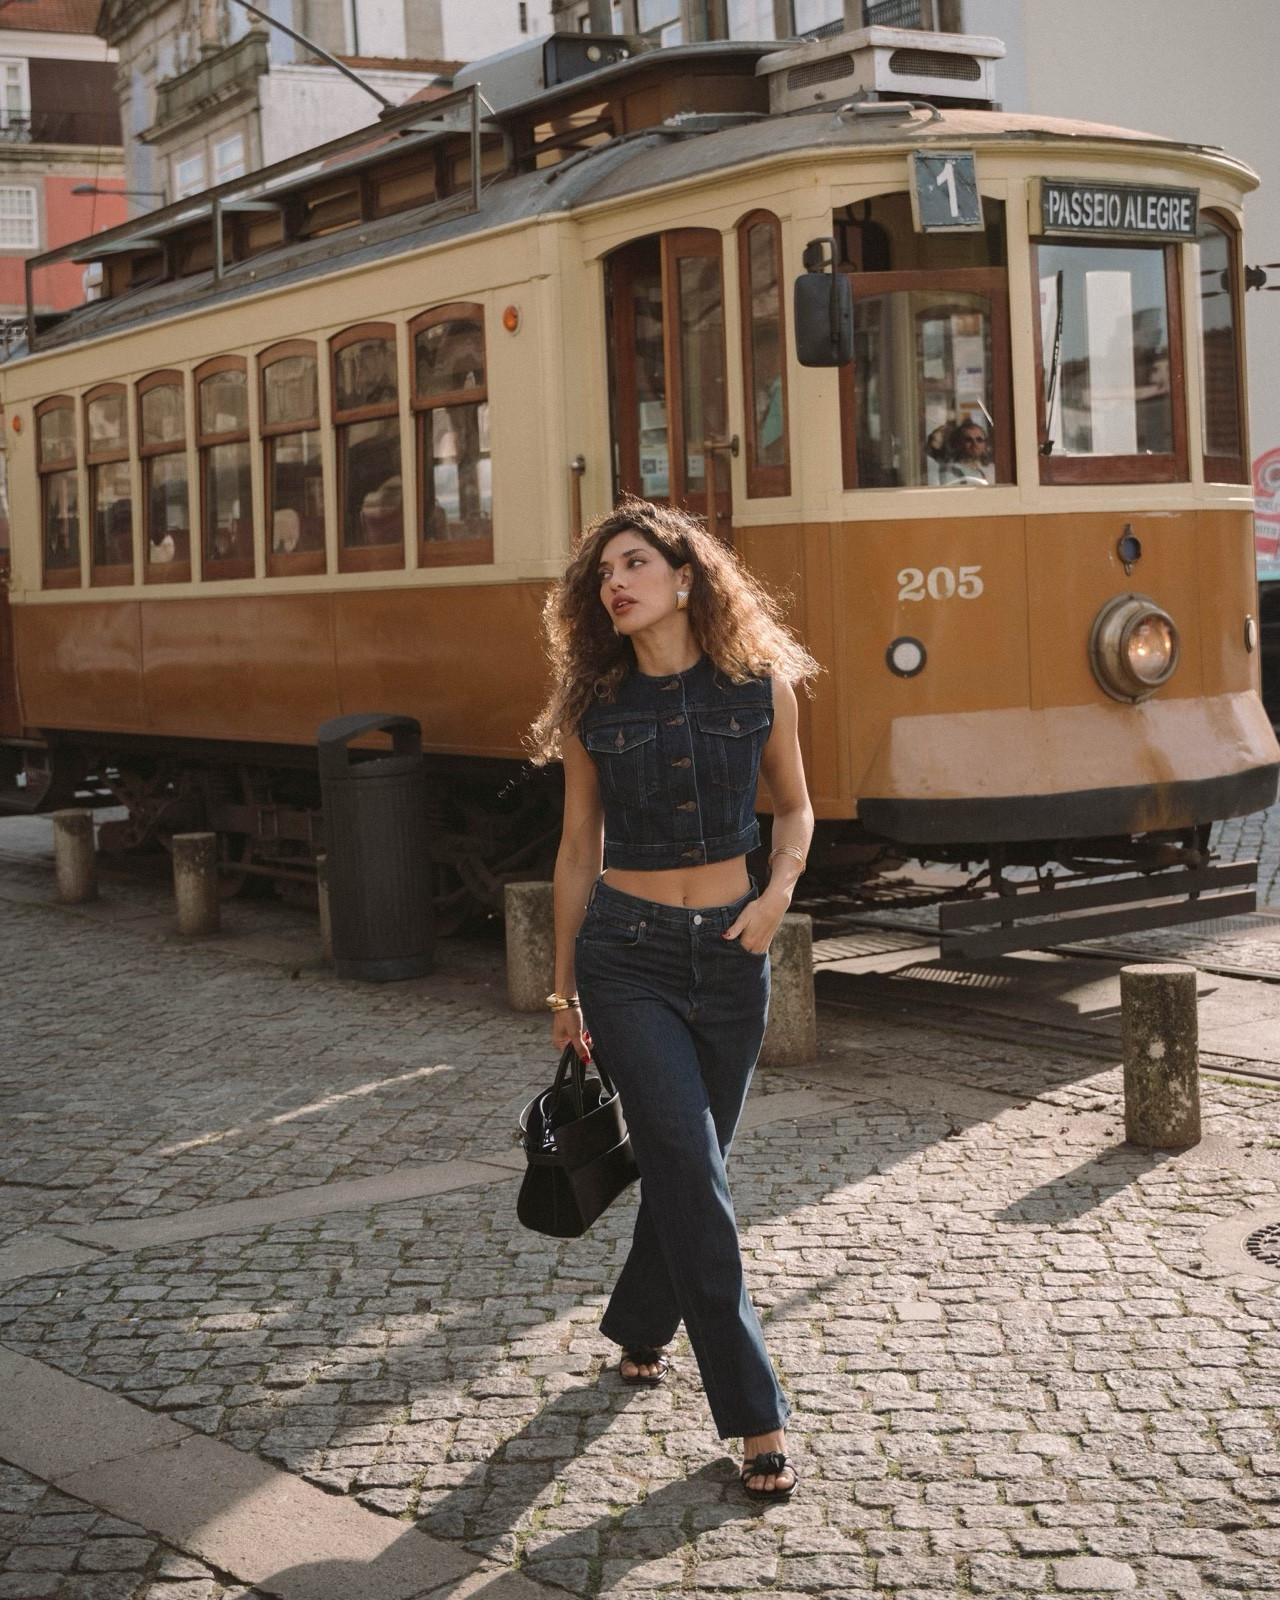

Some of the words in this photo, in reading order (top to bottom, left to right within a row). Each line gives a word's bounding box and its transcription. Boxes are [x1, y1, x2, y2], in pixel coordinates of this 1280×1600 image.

[936, 160, 960, 218] 1
[1049, 190, 1120, 228] PASSEIO
[1124, 195, 1191, 231] ALEGRE
[897, 565, 984, 602] 205
